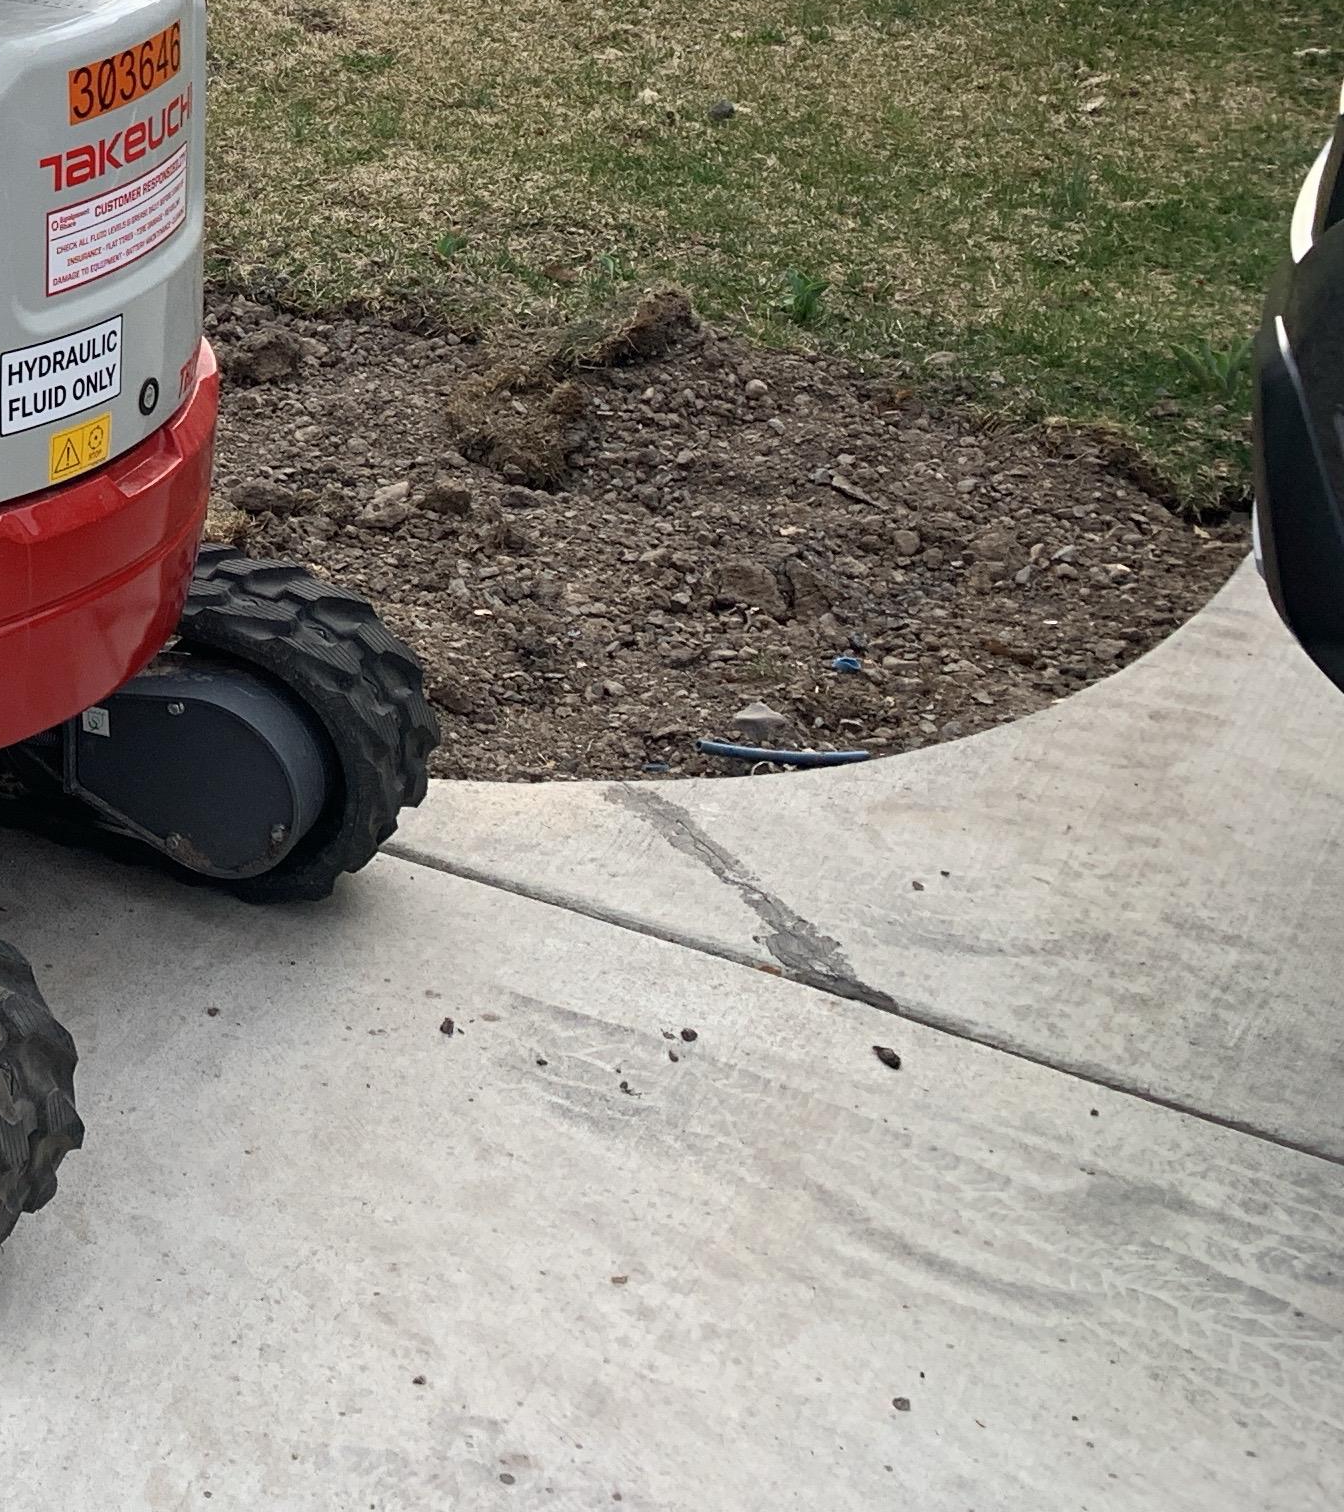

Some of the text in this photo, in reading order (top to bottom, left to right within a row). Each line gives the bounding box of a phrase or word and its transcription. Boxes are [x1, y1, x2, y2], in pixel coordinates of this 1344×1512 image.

[73, 22, 181, 119] 303646
[95, 186, 142, 217] CUSTOMER
[6, 329, 117, 386] HYDRAULIC
[7, 363, 116, 422] FLUID ONLY
